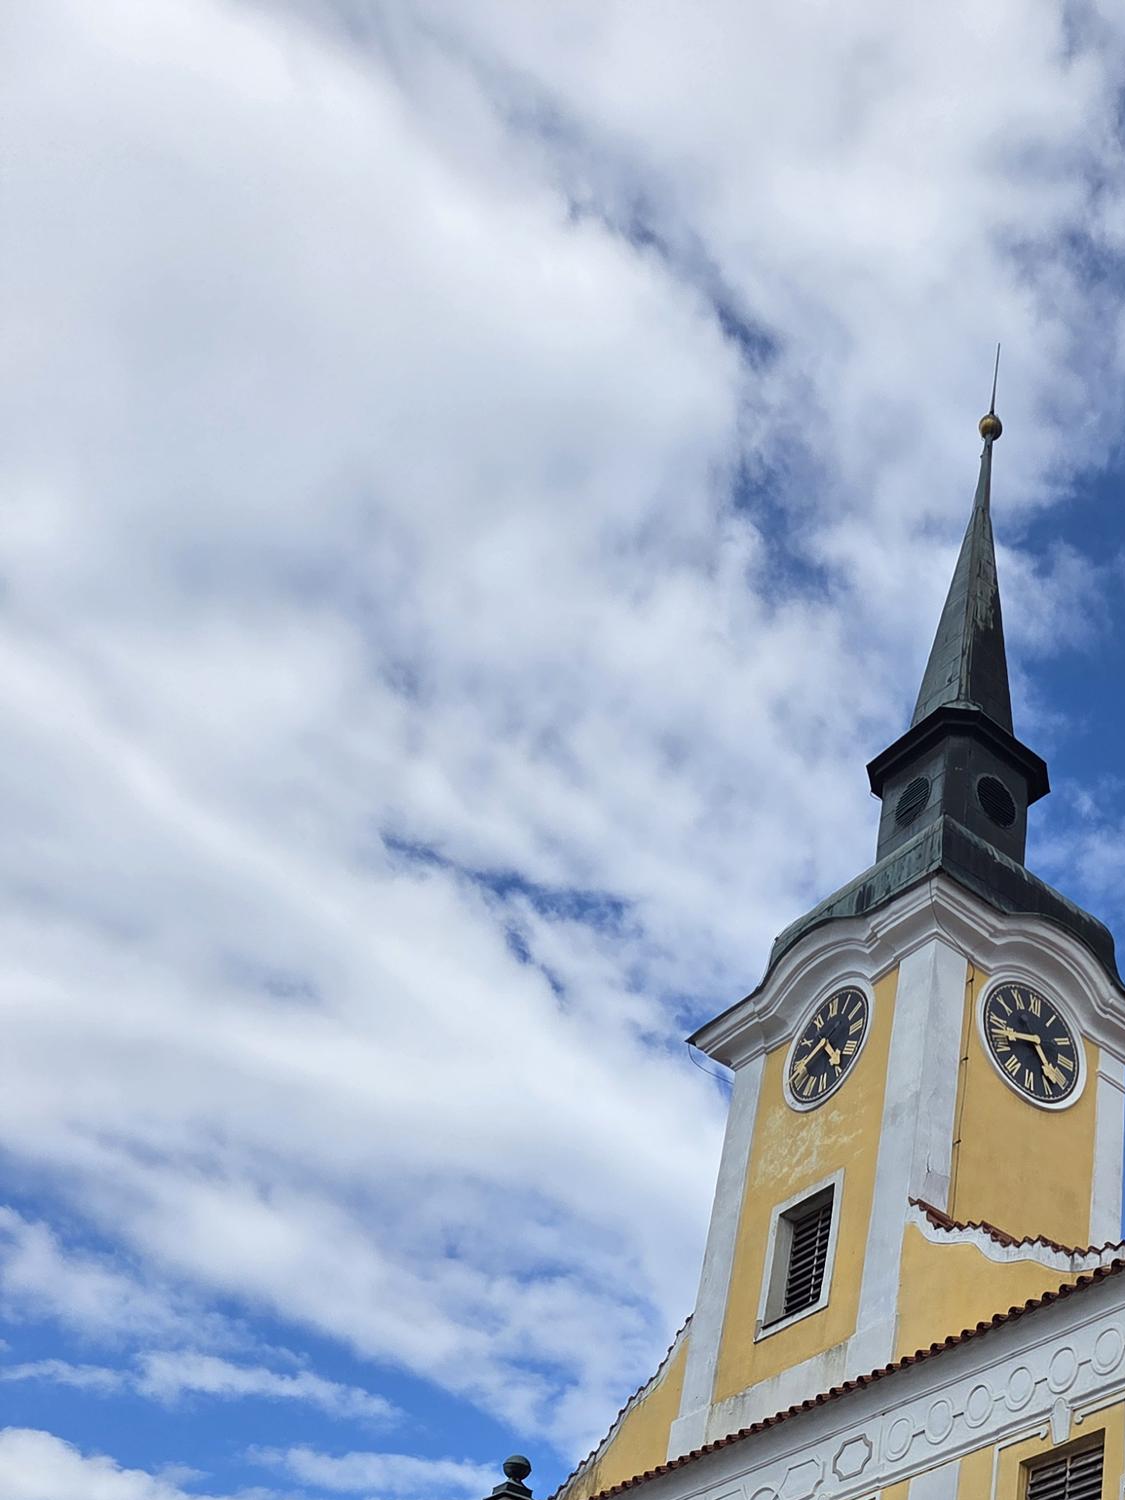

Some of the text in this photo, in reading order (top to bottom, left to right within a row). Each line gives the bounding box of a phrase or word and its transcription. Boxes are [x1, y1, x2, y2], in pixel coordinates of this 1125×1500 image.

[827, 997, 839, 1021] XII
[841, 994, 851, 1015] I
[996, 994, 1013, 1017] X
[1011, 989, 1025, 1010] XI
[1028, 993, 1041, 1018] XII
[848, 1001, 863, 1021] II
[1045, 1014, 1056, 1028] I
[814, 1014, 825, 1032] XI
[849, 1017, 864, 1036] III
[801, 1038, 814, 1048] X
[842, 1040, 858, 1055] IIII
[1054, 1037, 1071, 1046] II
[1004, 1054, 1021, 1077] VII
[1057, 1053, 1074, 1072] III
[802, 1076, 817, 1097] VII
[818, 1072, 827, 1093] VI
[1024, 1068, 1034, 1091] VI
[1041, 1074, 1053, 1096] V
